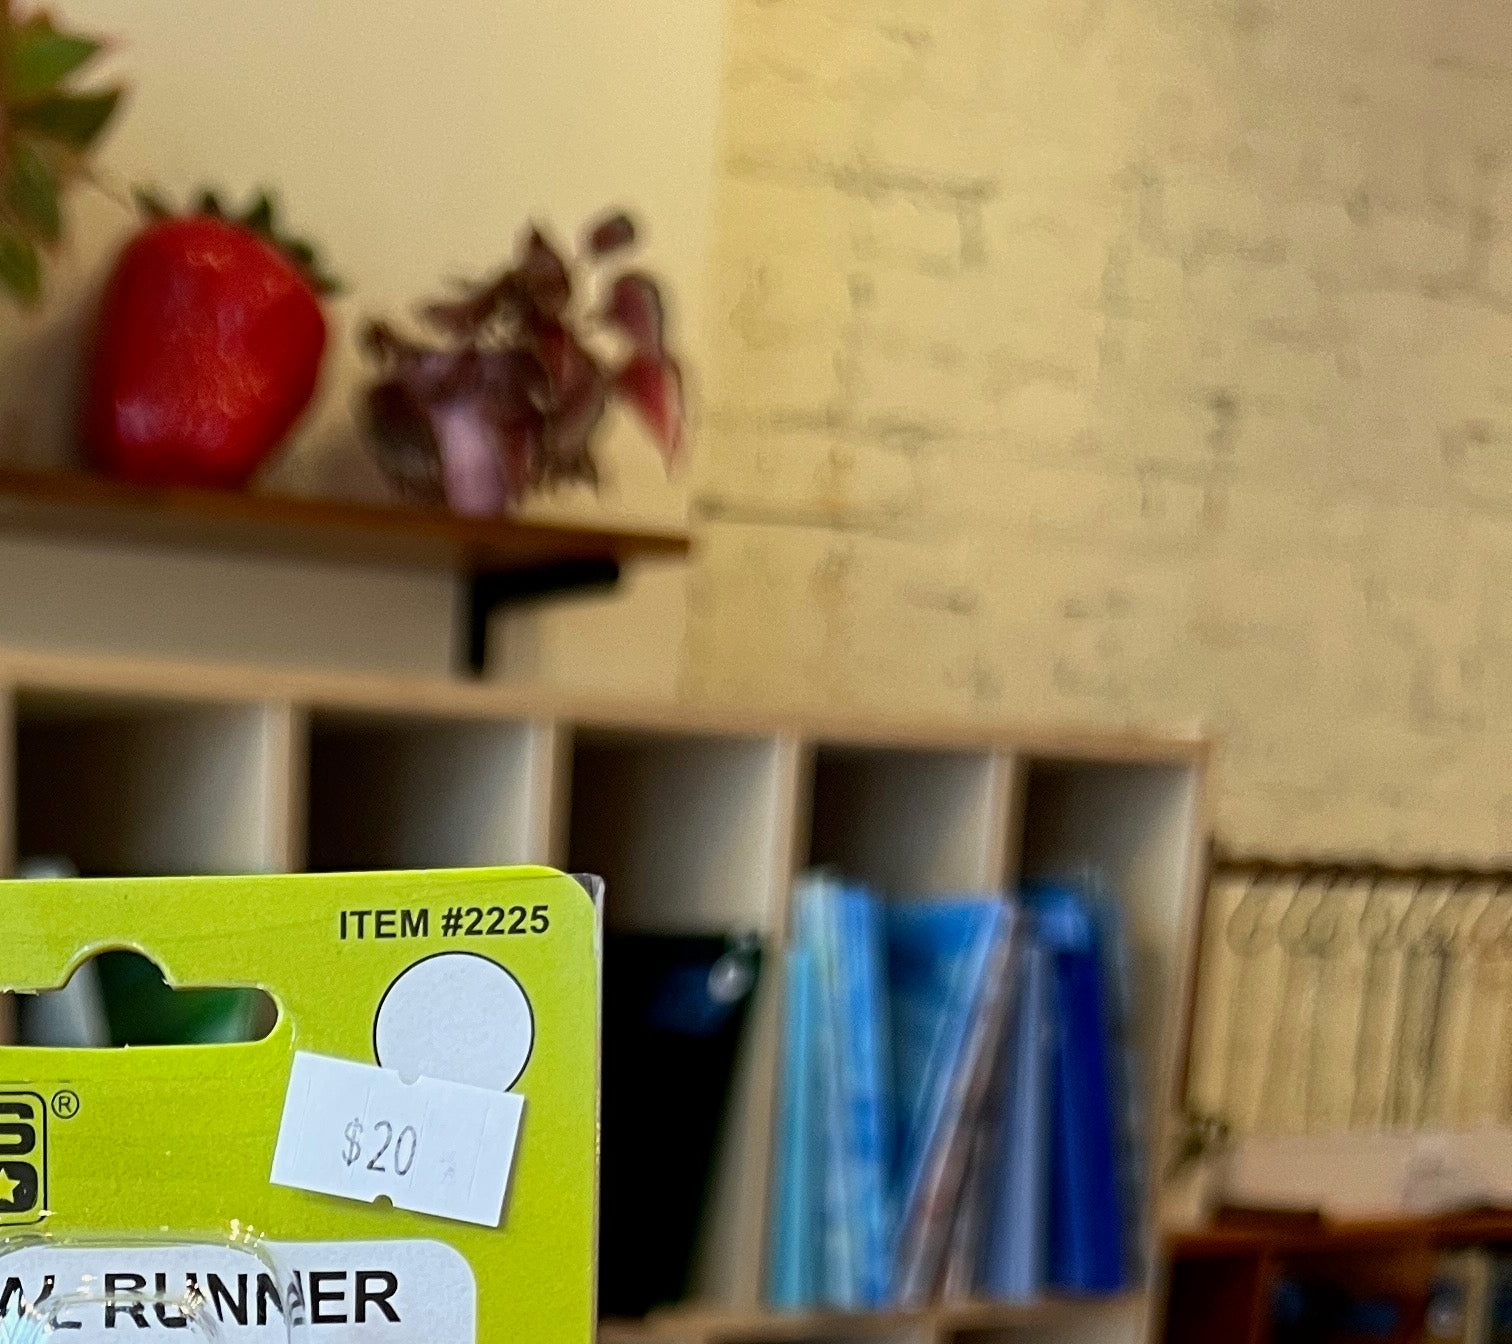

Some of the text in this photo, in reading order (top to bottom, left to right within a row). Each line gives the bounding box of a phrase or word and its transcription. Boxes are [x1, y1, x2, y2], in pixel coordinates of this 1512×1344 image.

[340, 905, 550, 940] ITEM #2225
[341, 1117, 418, 1177] $20
